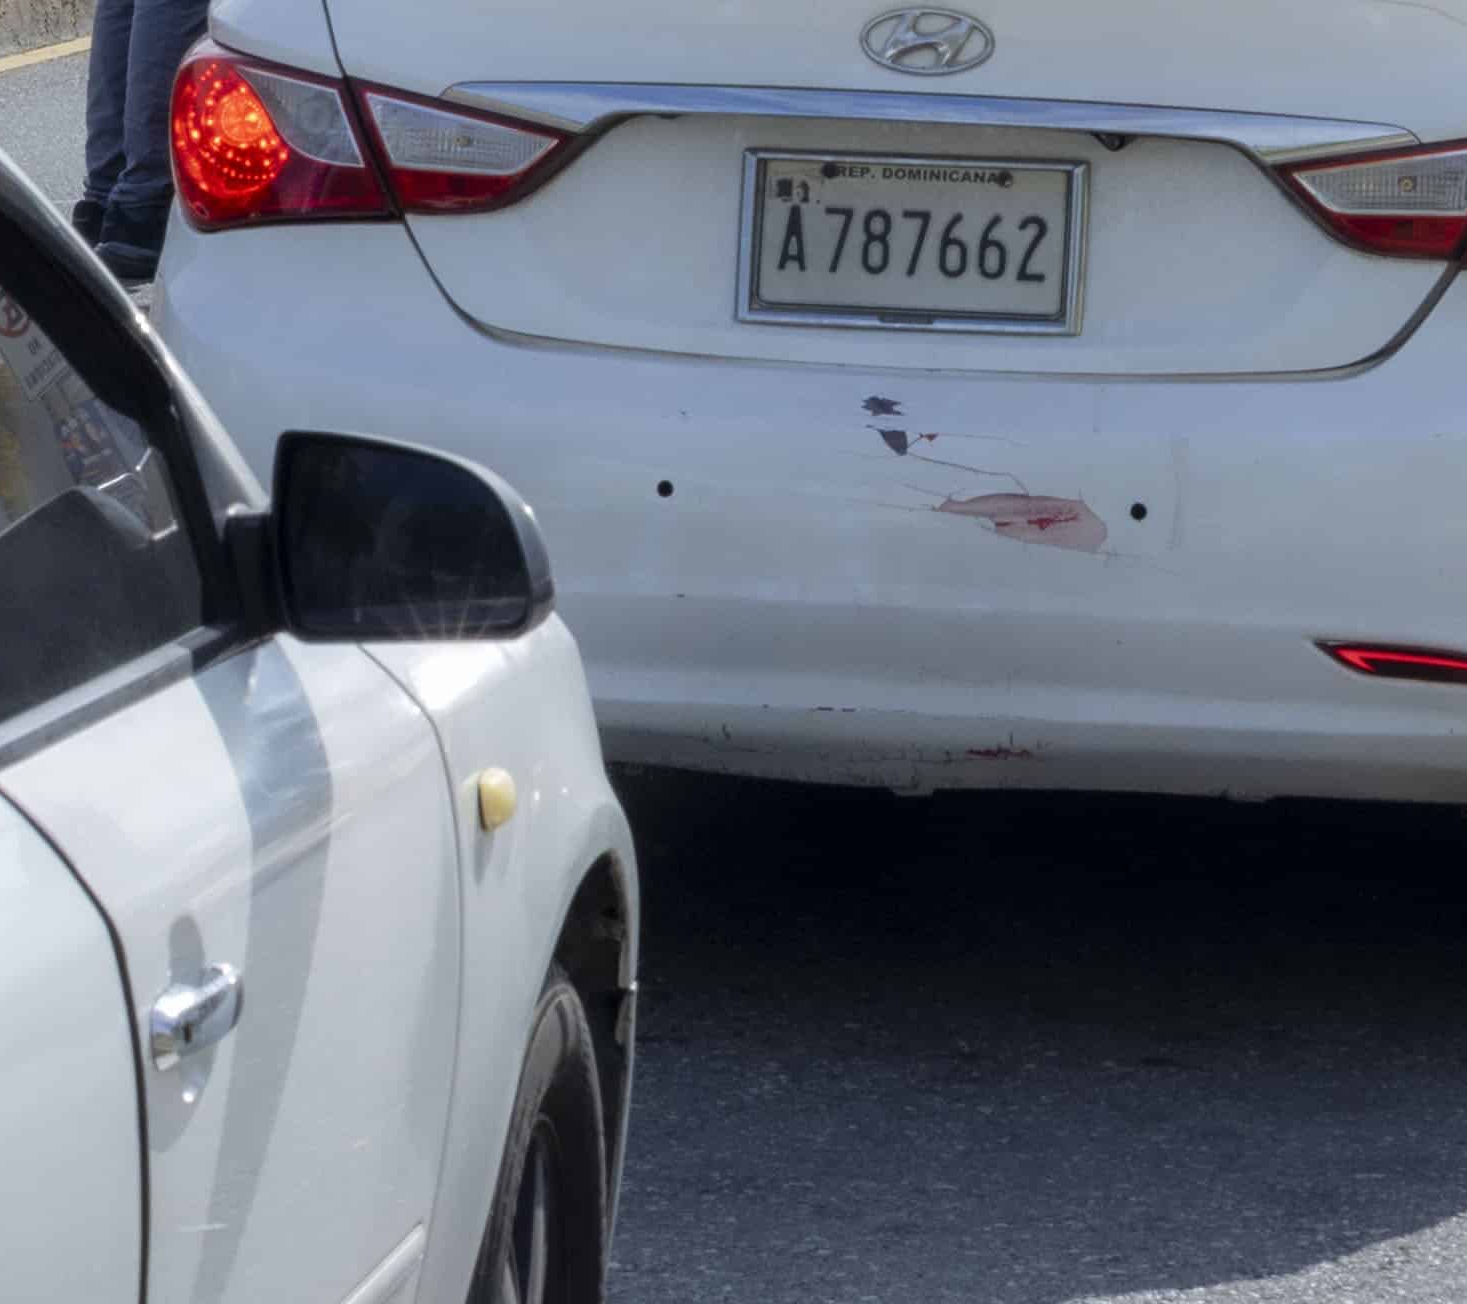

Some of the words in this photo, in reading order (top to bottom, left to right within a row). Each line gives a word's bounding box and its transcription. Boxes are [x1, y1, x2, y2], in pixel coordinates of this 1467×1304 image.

[837, 165, 876, 179] REP.
[882, 168, 1000, 185] DOMINICANA
[778, 203, 1049, 283] A787662
